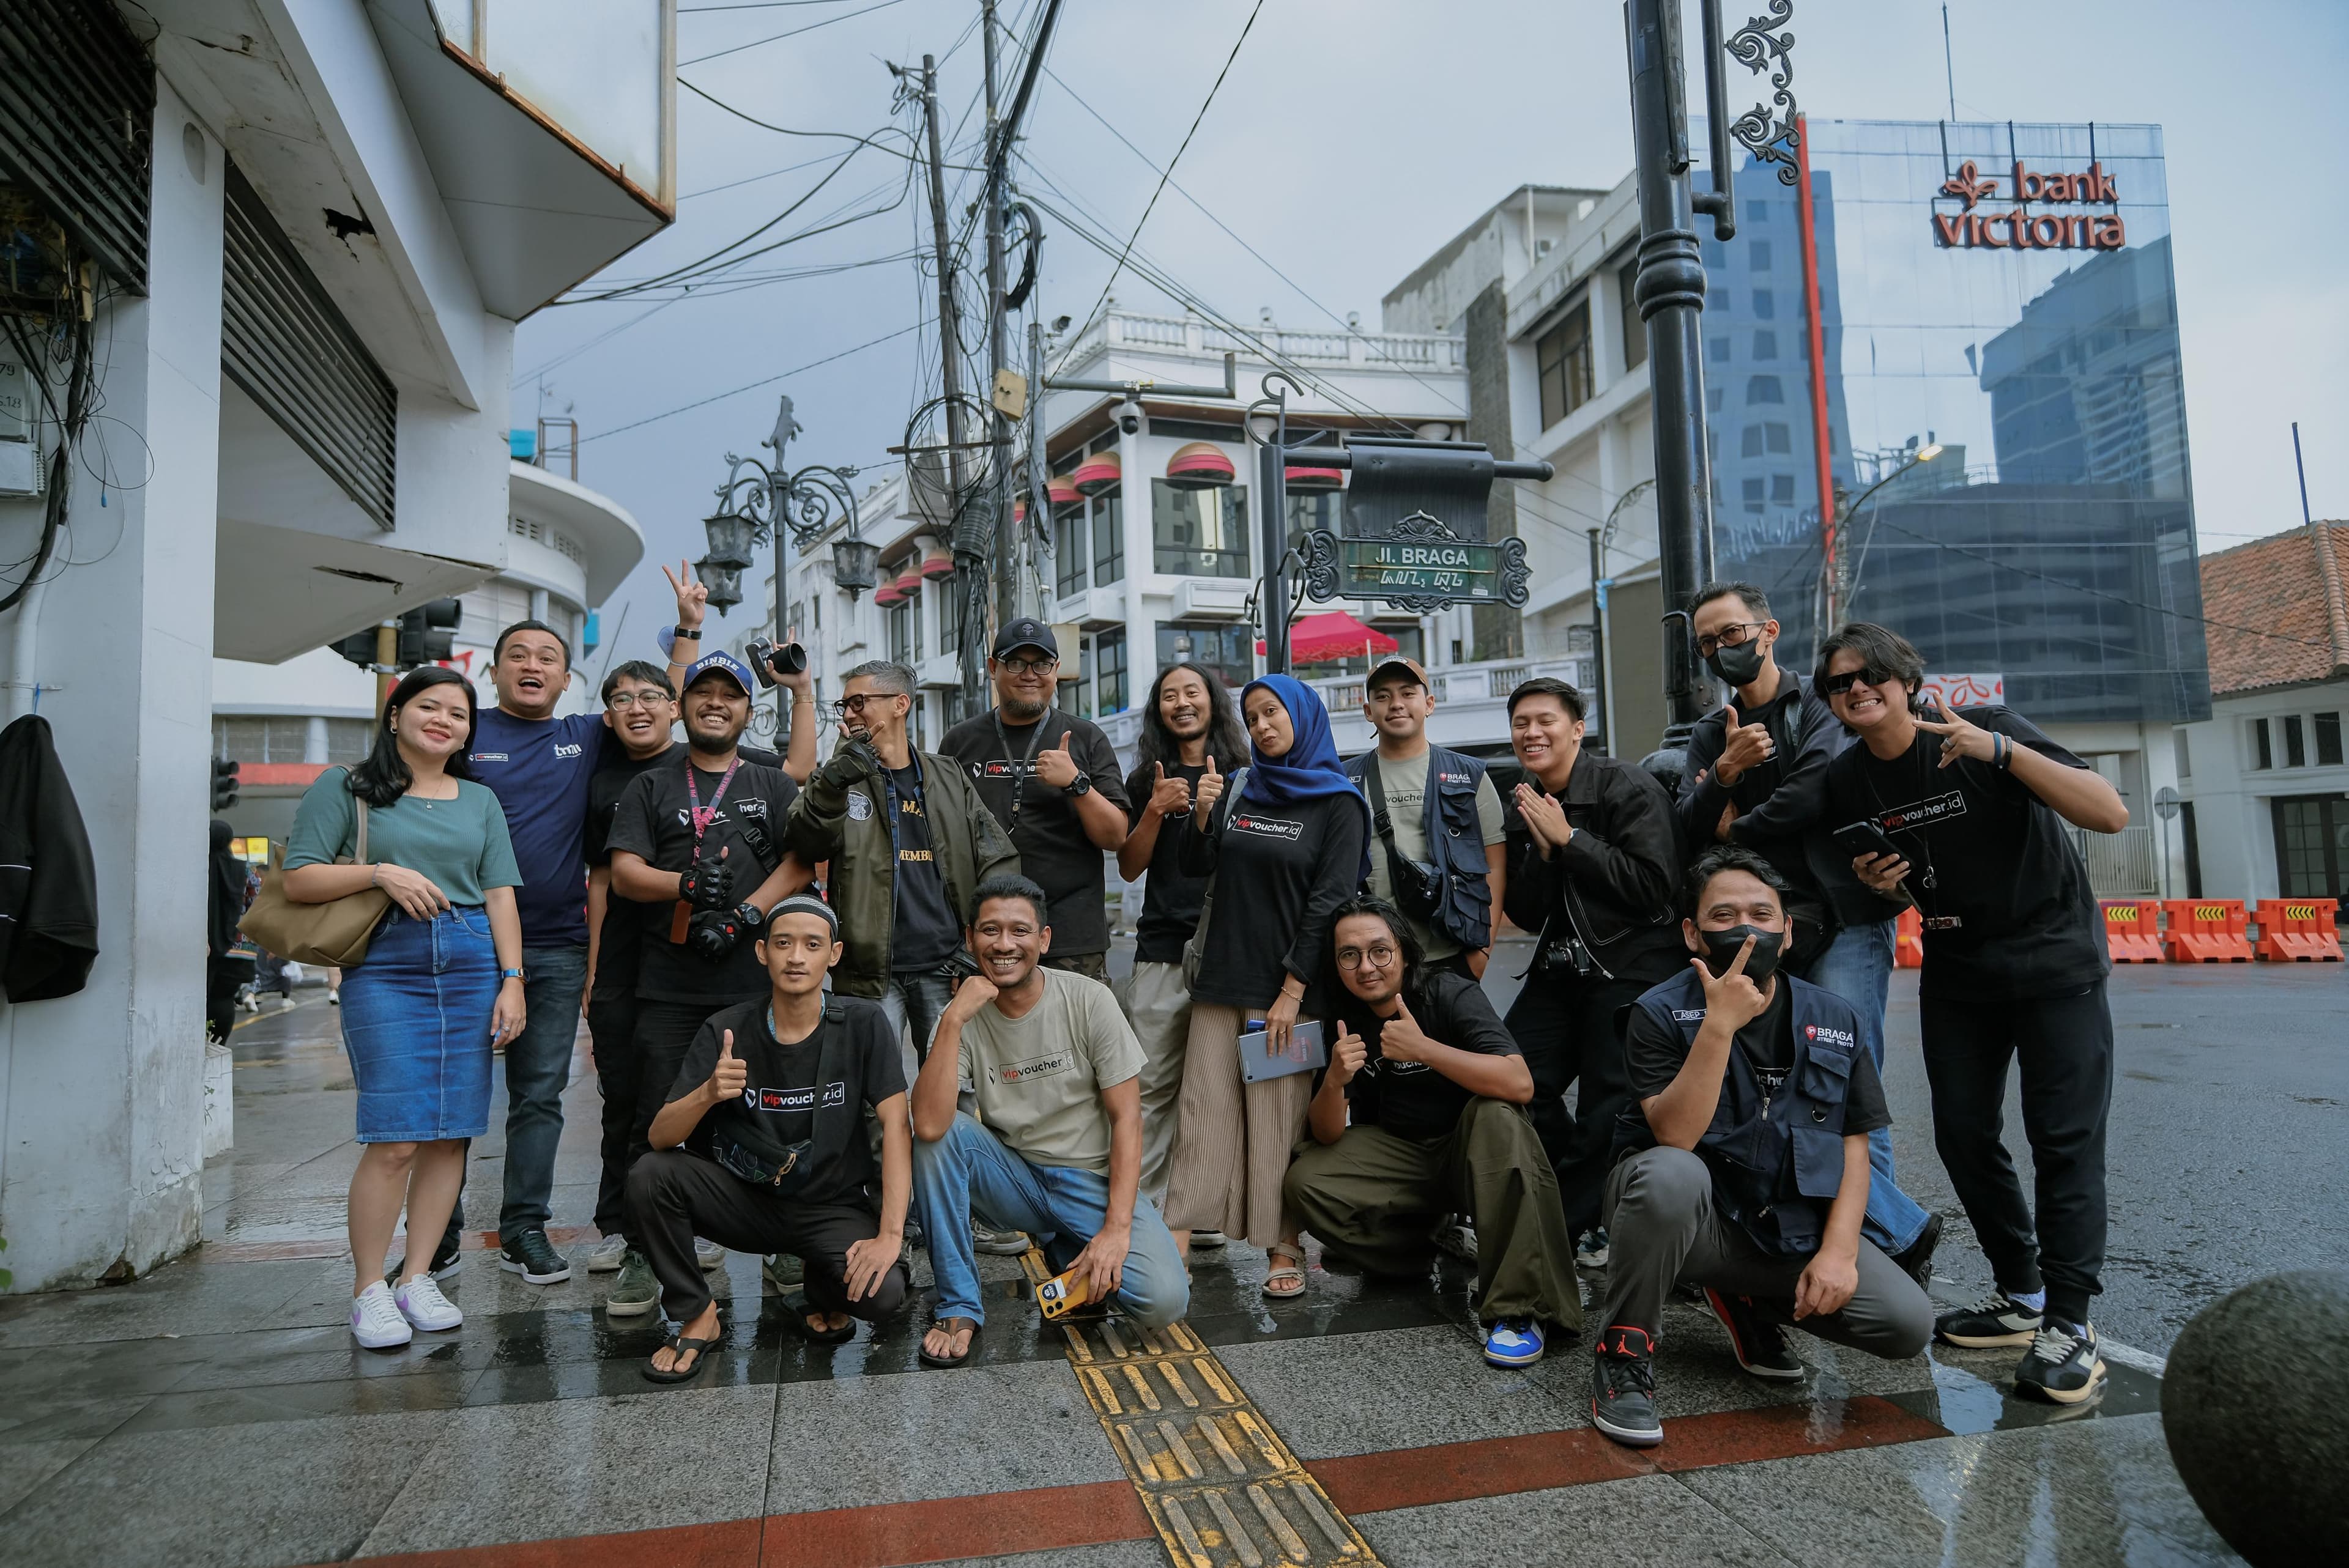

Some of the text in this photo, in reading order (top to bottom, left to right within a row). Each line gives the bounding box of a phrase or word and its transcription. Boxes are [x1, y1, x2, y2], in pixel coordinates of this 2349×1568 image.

[2016, 160, 2120, 201] bank
[1936, 209, 2126, 248] victoria
[1401, 548, 1469, 566] BRAGA
[1238, 818, 1299, 835] vipvoucher.id
[1817, 1027, 1854, 1042] BRAGA
